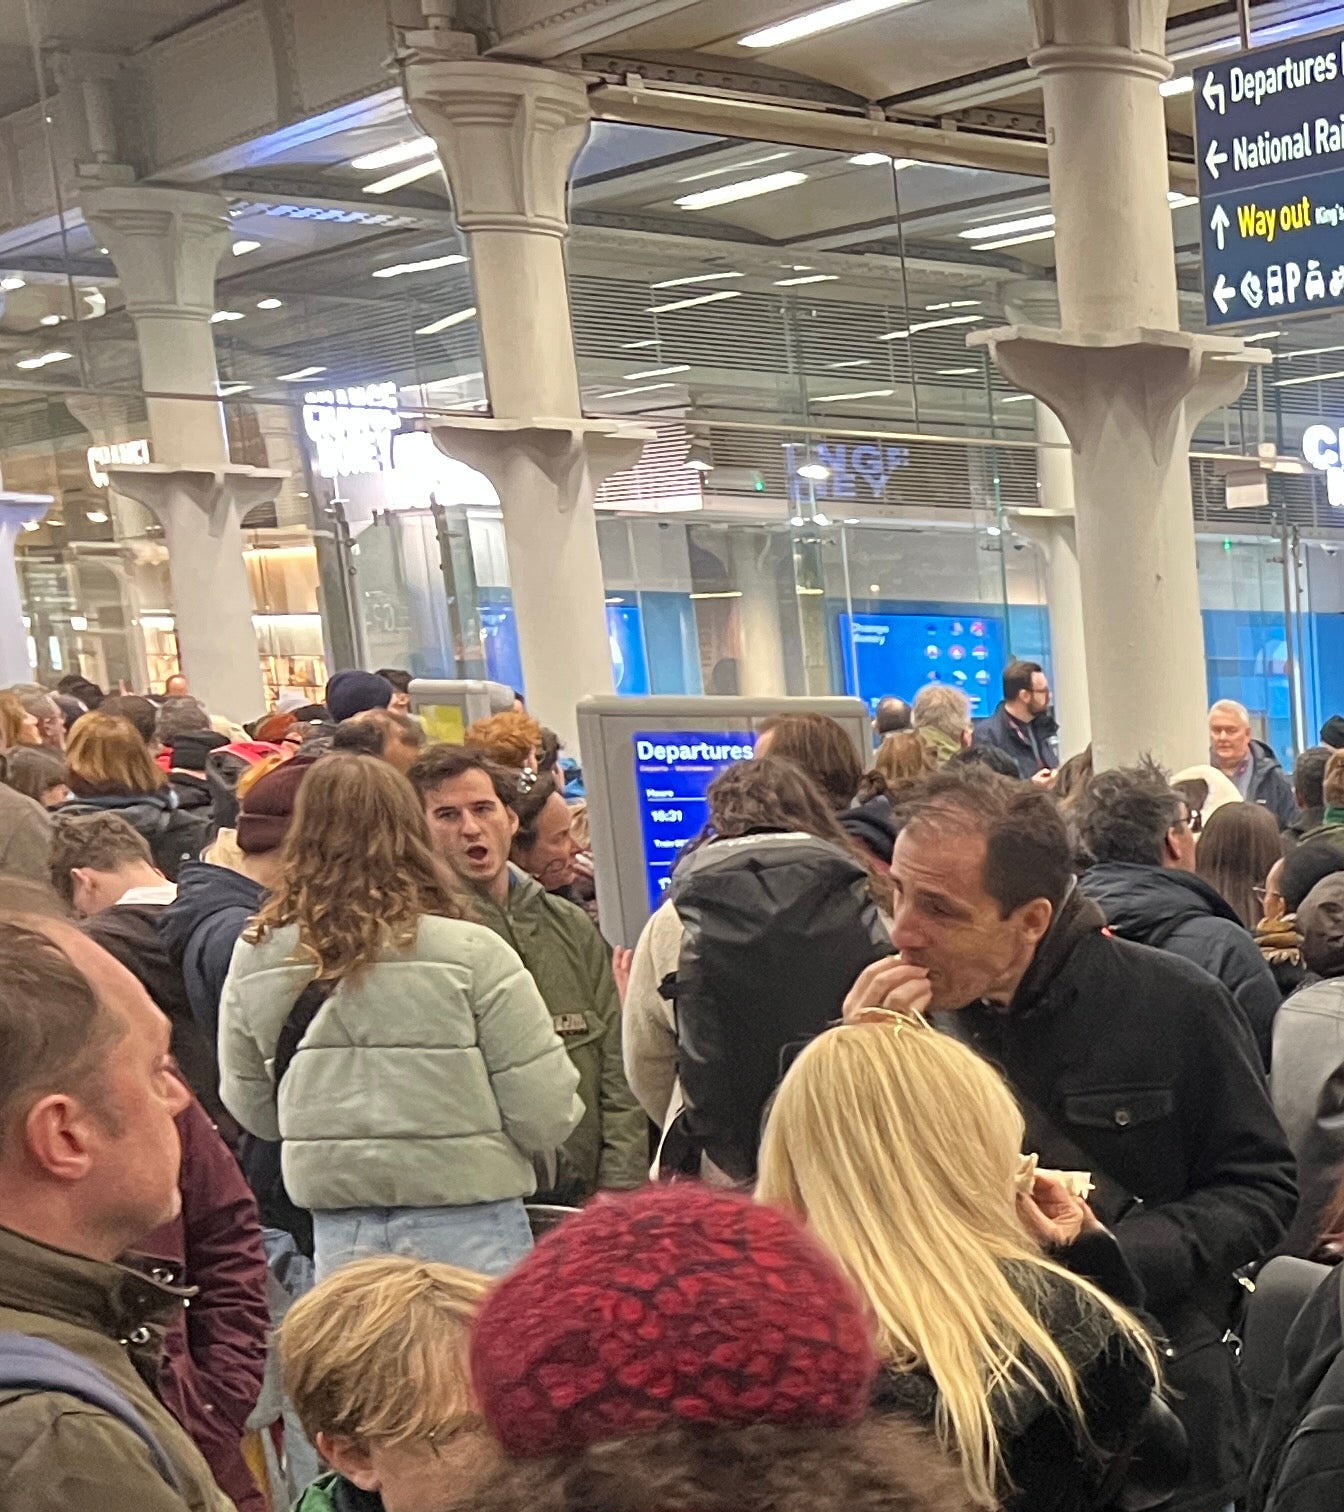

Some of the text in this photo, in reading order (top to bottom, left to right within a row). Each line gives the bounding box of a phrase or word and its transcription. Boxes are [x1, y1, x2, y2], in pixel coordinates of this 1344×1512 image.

[1230, 52, 1338, 106] Departures
[1232, 121, 1312, 172] National
[1236, 202, 1276, 242] Way
[1280, 195, 1312, 232] out
[637, 740, 754, 765] Departures
